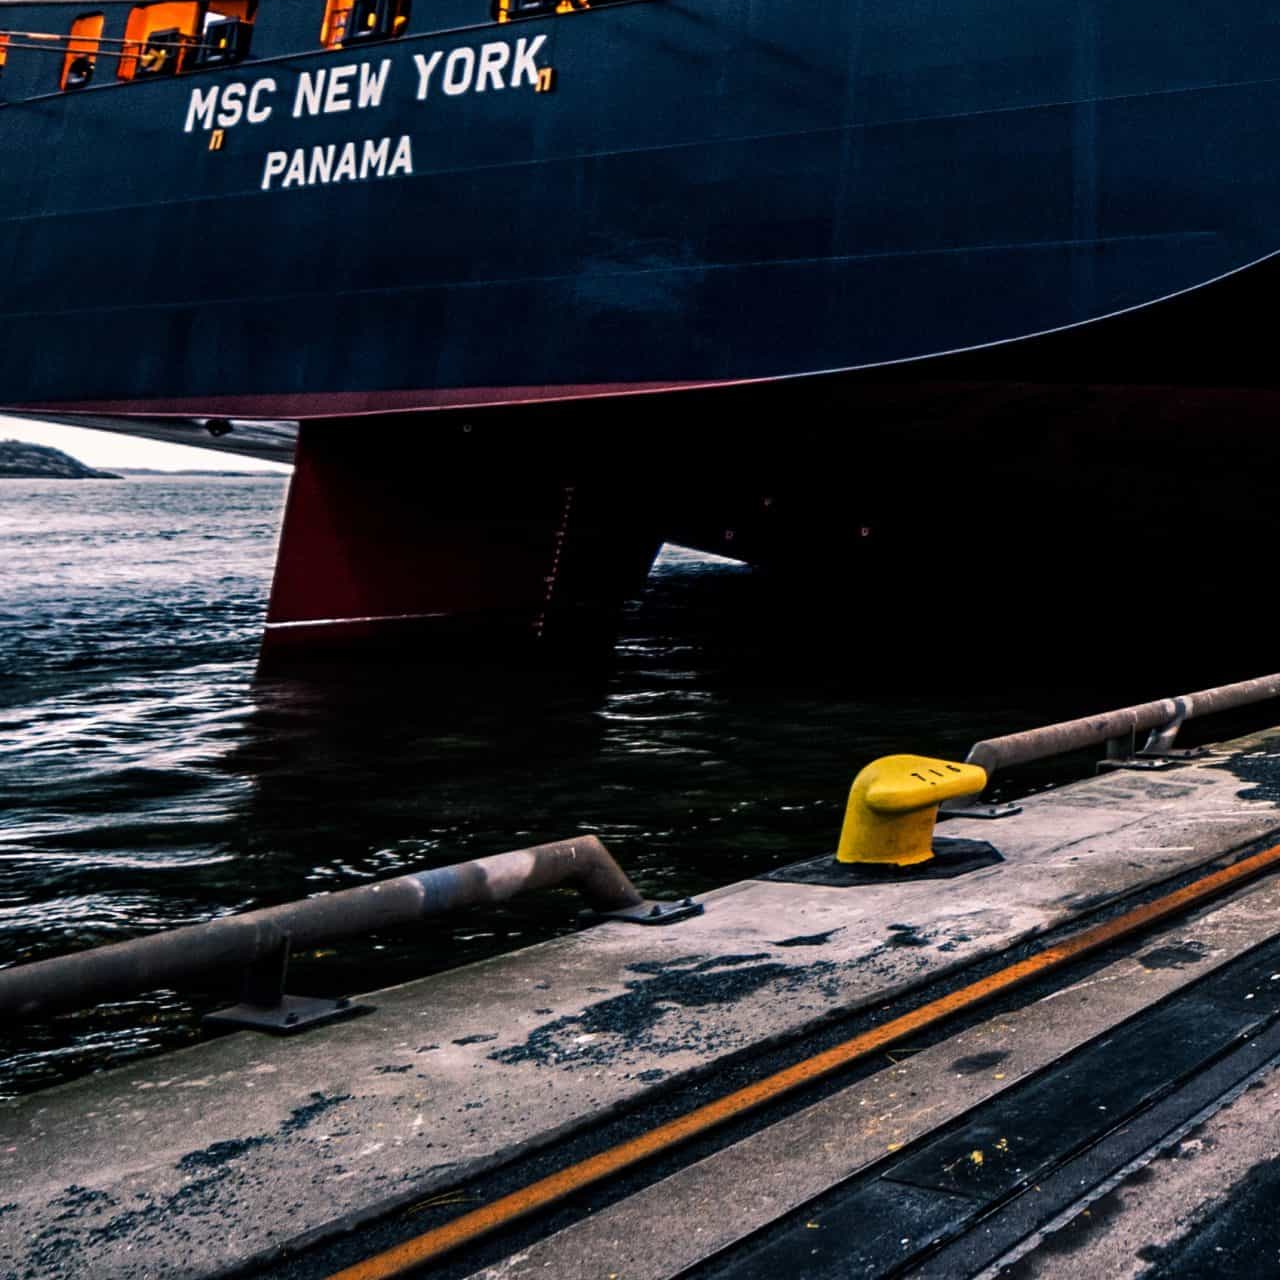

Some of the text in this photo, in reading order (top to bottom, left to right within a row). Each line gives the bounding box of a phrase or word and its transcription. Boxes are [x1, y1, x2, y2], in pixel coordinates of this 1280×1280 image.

[184, 35, 547, 132] MSC NEW YORK
[261, 135, 413, 190] PANAMA
